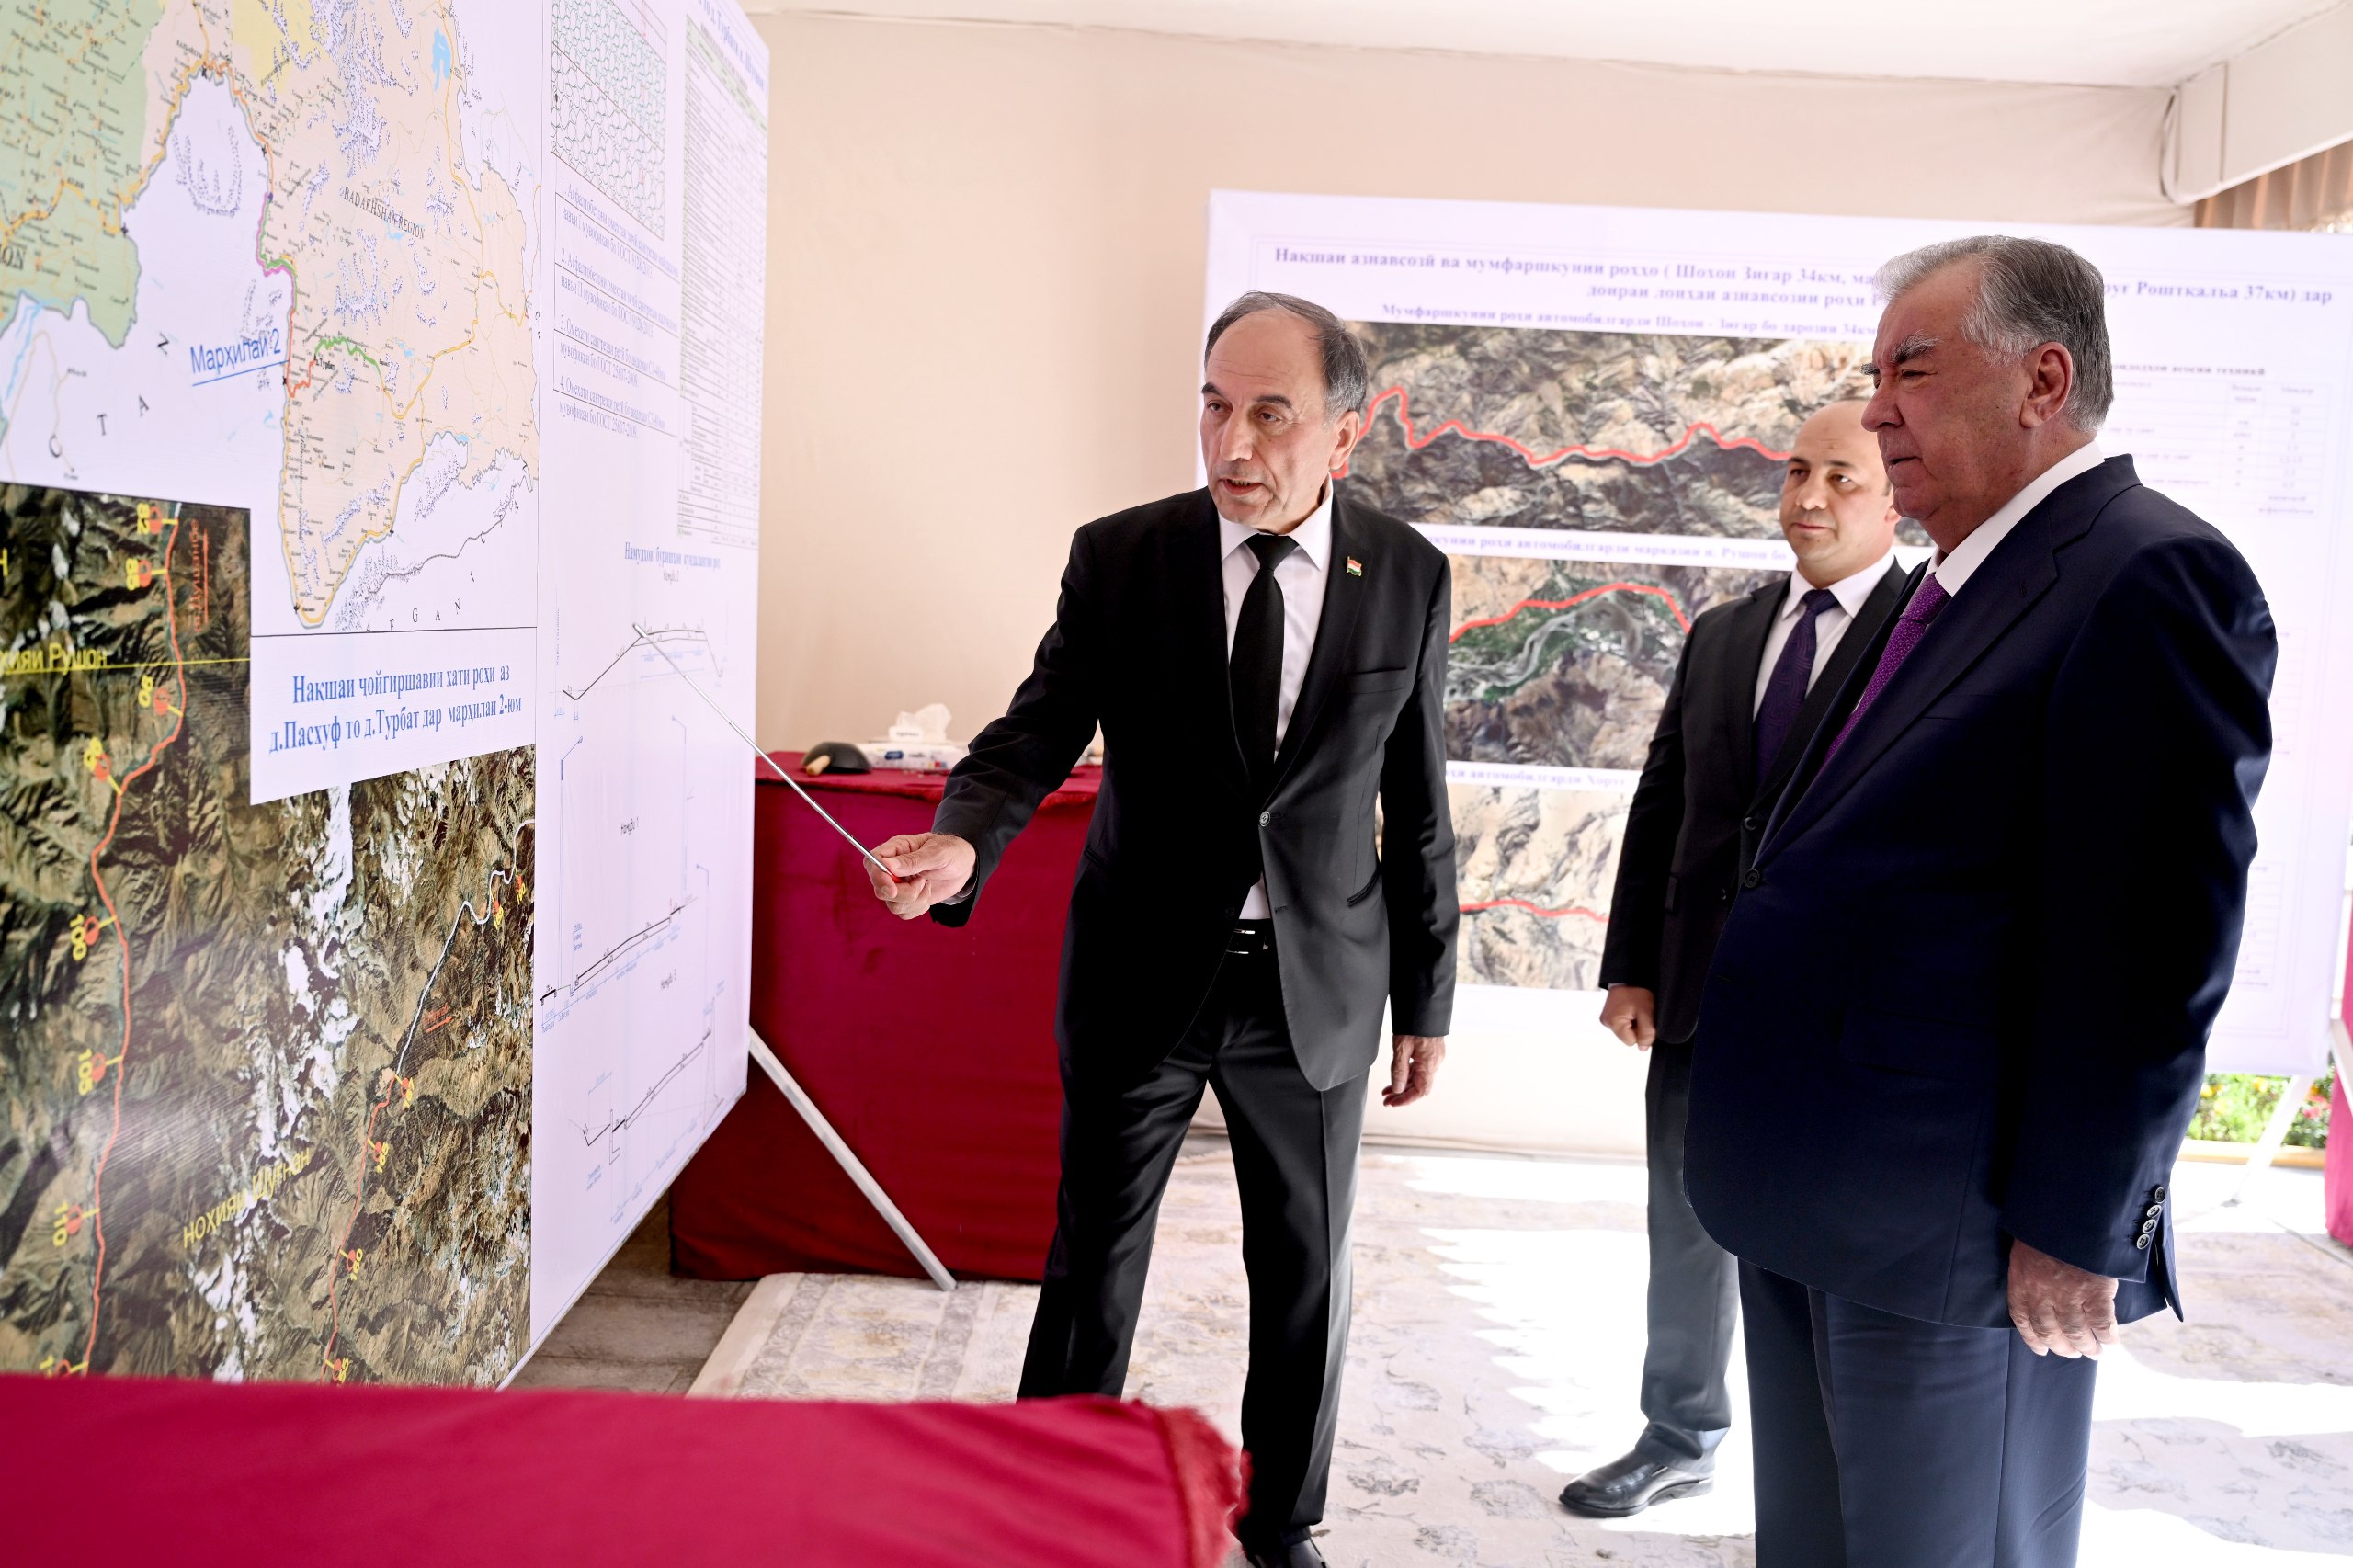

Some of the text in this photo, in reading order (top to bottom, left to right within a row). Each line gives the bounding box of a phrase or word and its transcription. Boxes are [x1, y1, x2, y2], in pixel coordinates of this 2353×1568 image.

[344, 186, 397, 225] BADAKHSHAN
[398, 214, 425, 240] REGION
[1441, 257, 1461, 269] ва
[1466, 256, 1604, 278] мумфаршкунии
[1722, 290, 1819, 305] азнавсозии
[2244, 284, 2296, 304] 37км)
[2300, 288, 2333, 305] дар
[271, 328, 281, 355] 2
[1761, 320, 1778, 332] бо
[137, 503, 150, 535] 82
[49, 643, 108, 676] Рушон
[139, 674, 154, 708] 90
[292, 676, 355, 704] Нақшаи
[358, 669, 443, 699] ҷойгиршавии
[446, 668, 471, 687] хати
[500, 665, 510, 682] аз
[269, 693, 521, 755] д.Пасхуф то д.Турбат дар марҳилаи 2-юм
[71, 913, 88, 961] 100
[78, 1047, 93, 1096] 105
[53, 1199, 69, 1248] 110
